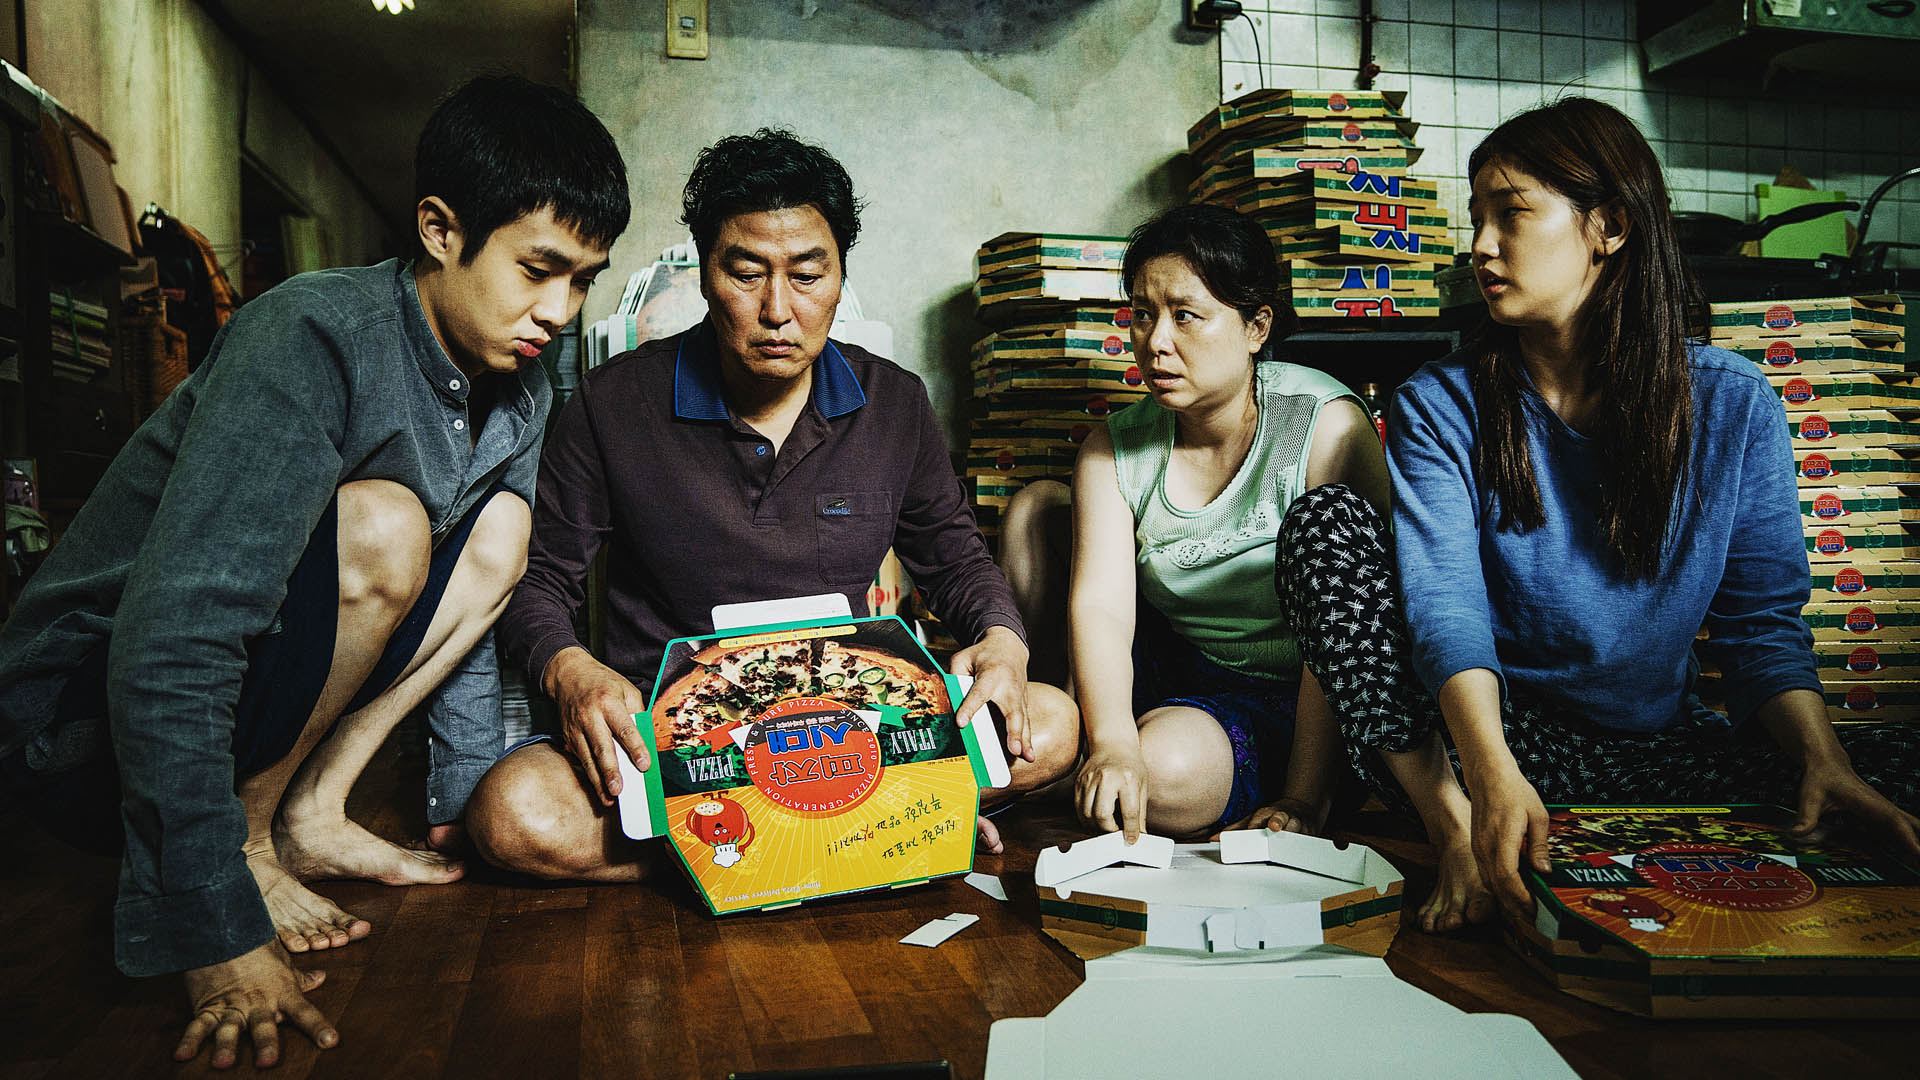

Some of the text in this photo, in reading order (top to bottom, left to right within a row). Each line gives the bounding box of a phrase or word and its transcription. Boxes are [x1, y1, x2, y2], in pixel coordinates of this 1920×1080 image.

[746, 741, 759, 776] FRESH
[757, 705, 784, 727] PURE
[788, 699, 825, 709] PIZZA
[766, 721, 852, 755] 시대
[840, 707, 877, 760] SINCE 2010
[890, 728, 937, 755] ITALY
[686, 754, 735, 783] PIZZA
[770, 753, 866, 786] 피자
[764, 773, 875, 811] PIZZA GENERATION
[904, 793, 942, 823] 푸짐한
[881, 819, 956, 859] 신선한 재료와
[1564, 868, 1630, 882] PIZZA
[1815, 867, 1885, 881] ITALY
